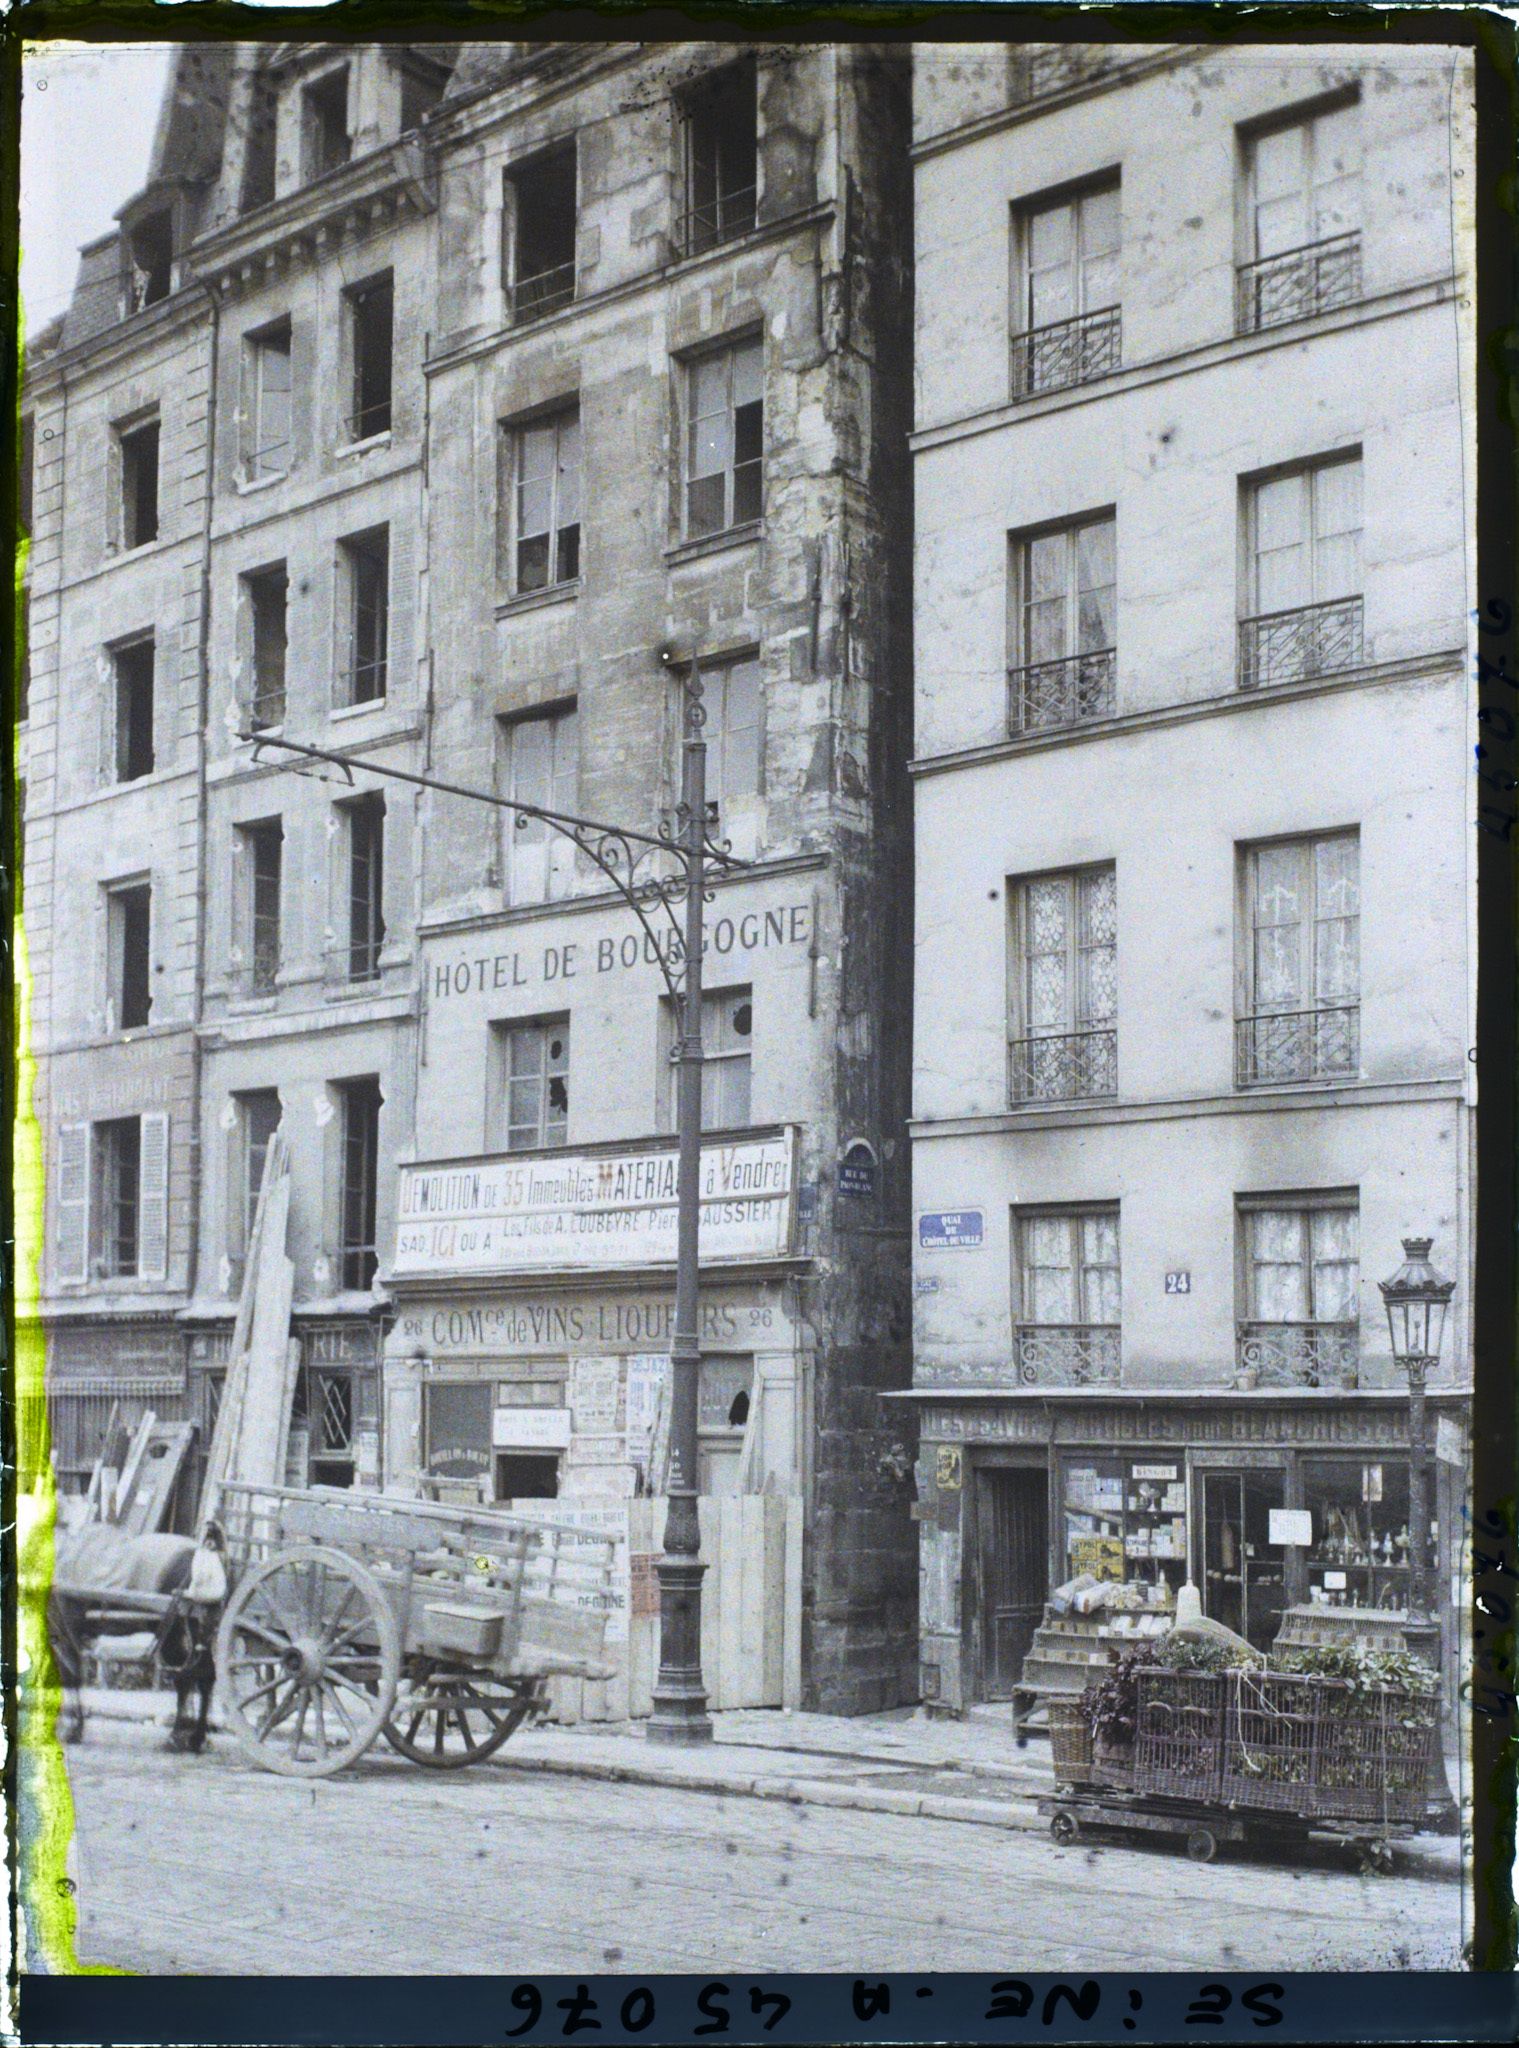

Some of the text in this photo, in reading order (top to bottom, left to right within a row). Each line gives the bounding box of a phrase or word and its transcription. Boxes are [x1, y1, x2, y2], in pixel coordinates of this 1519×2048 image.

[434, 905, 809, 998] HÔTEL DE BOURGOGNE
[503, 1170, 524, 1206] 35
[528, 1167, 595, 1205] Immeubles
[598, 1159, 680, 1201] MATERIA
[721, 1146, 782, 1192] Vendre
[702, 1200, 772, 1227] AUSSIER
[941, 1214, 961, 1227] QUAI
[431, 1225, 458, 1258] ICI
[460, 1233, 477, 1251] OU
[1167, 1272, 1188, 1293] 24
[507, 1309, 527, 1343] de
[527, 1305, 584, 1343] VINS
[599, 1303, 737, 1342] LIQUERS
